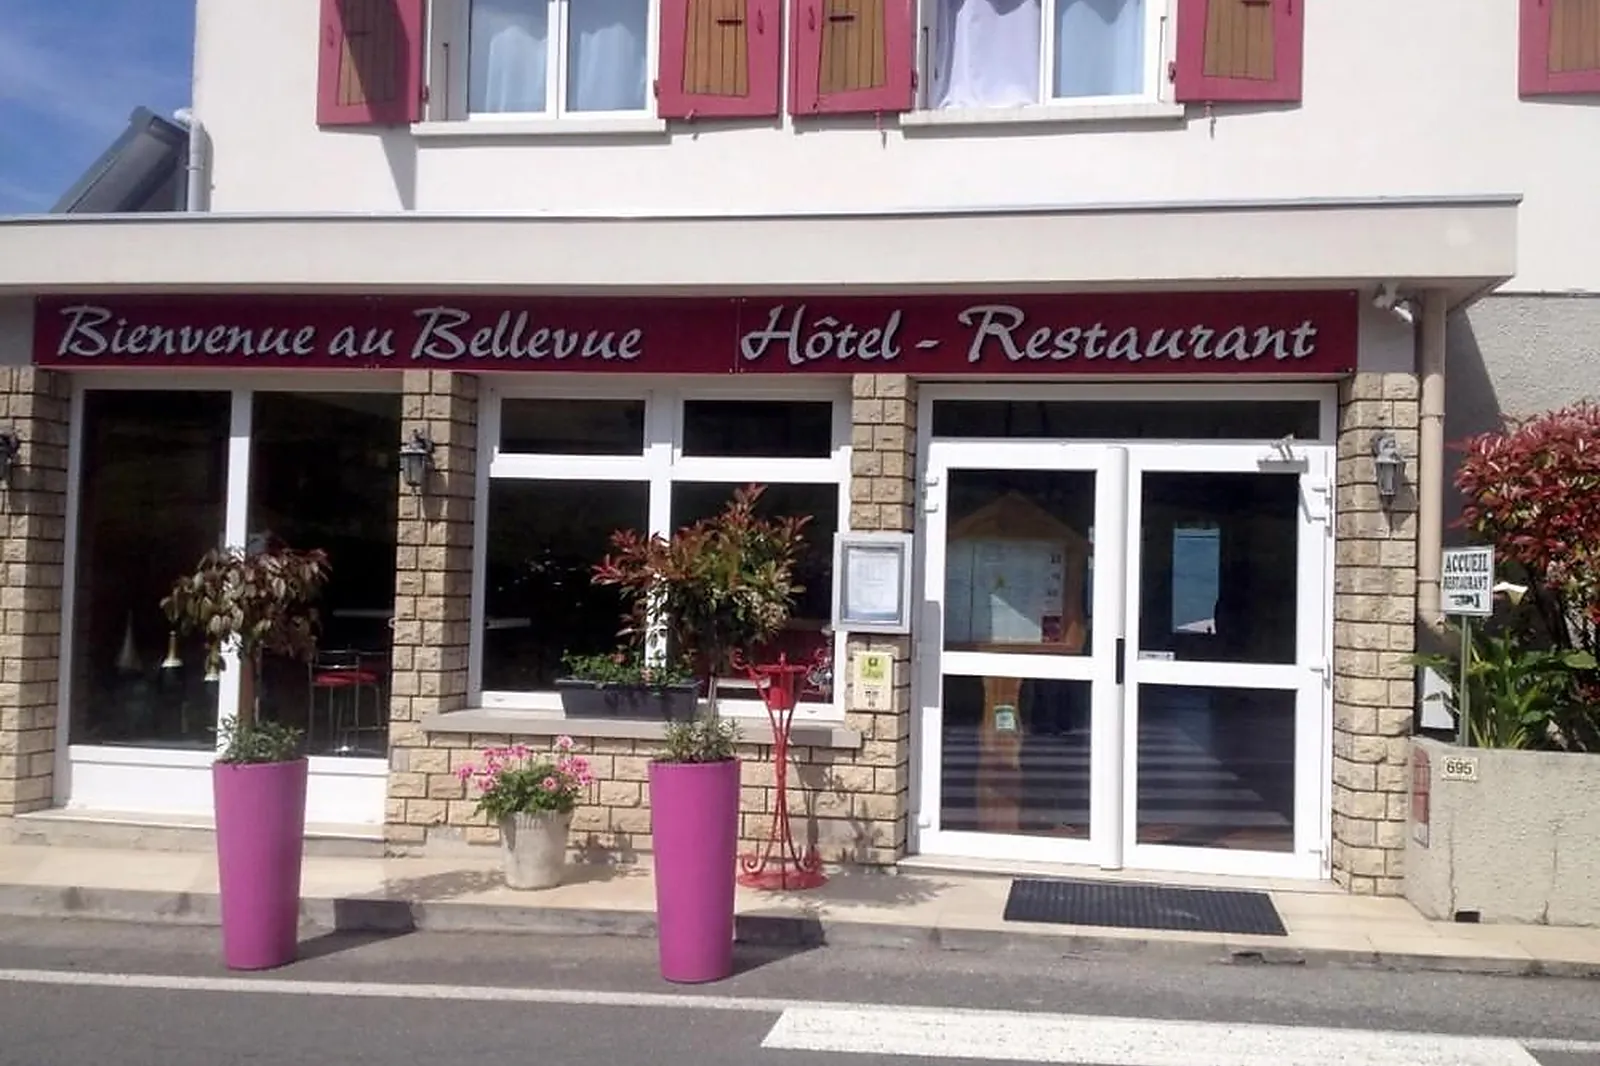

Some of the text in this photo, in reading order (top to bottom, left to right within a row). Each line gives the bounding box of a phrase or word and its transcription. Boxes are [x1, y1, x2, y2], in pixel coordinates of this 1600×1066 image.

[57, 305, 642, 361] Bienvenue au Bellevue
[740, 304, 1318, 364] Hôtel - Restaurant
[1444, 553, 1488, 572] ACCUEIL
[1446, 761, 1473, 775] 695
